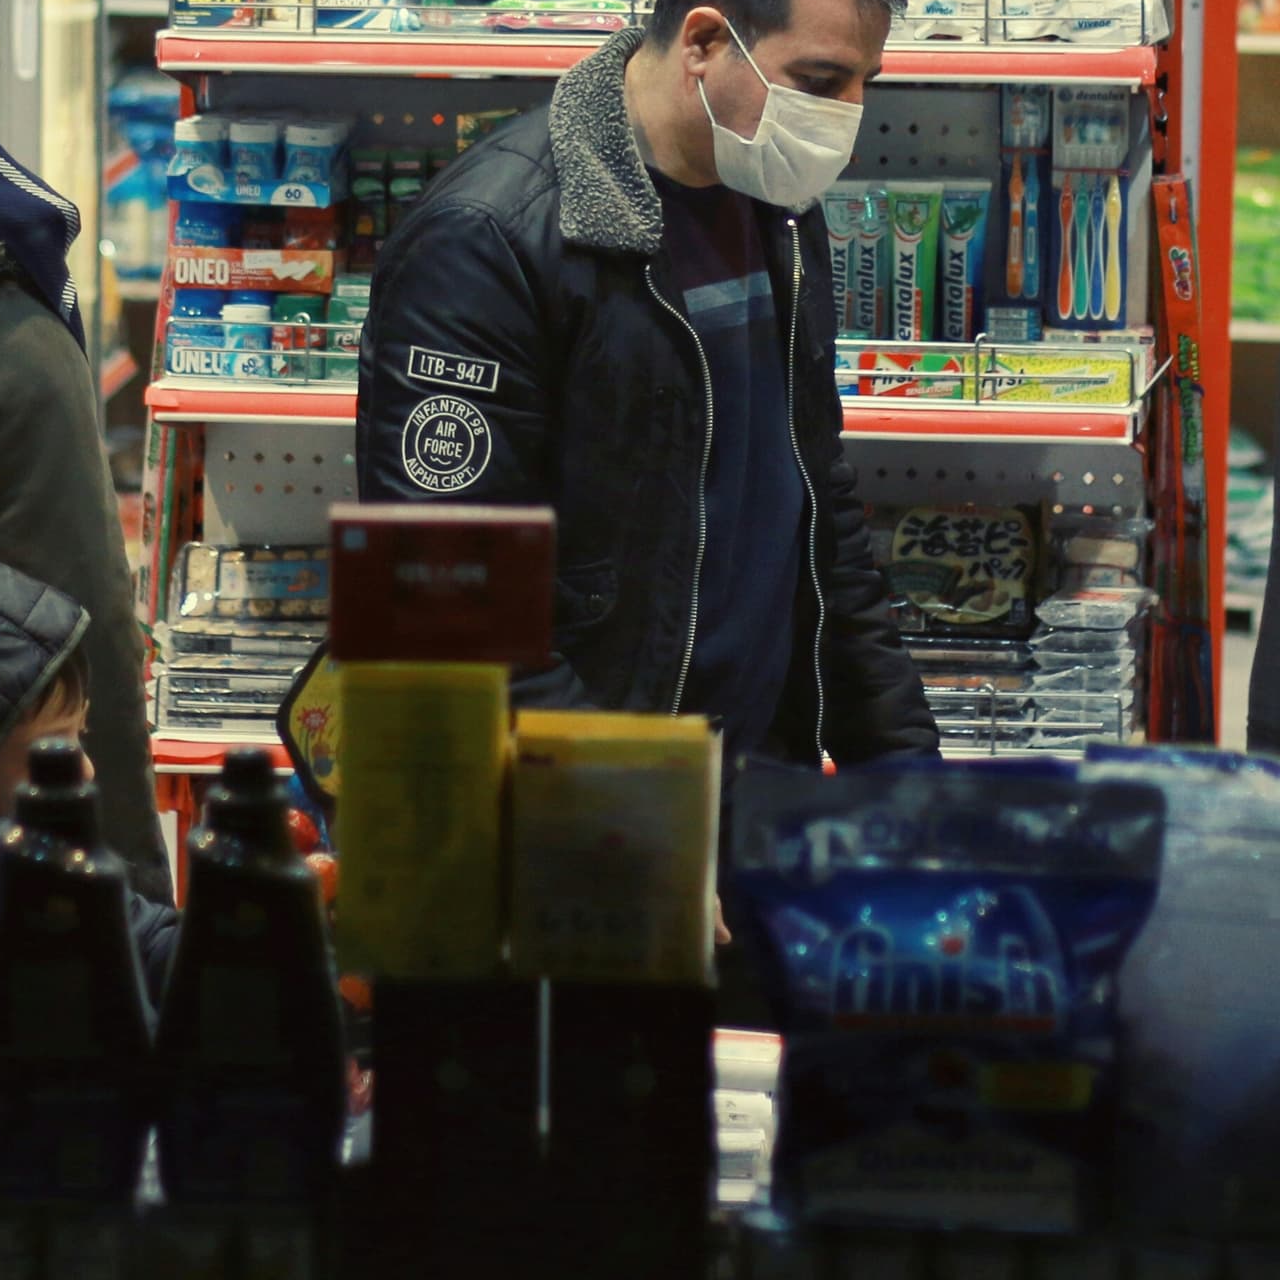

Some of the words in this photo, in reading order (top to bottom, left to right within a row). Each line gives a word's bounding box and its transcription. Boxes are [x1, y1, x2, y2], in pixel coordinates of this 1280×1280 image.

[284, 189, 301, 200] 60
[175, 257, 230, 284] ONEO
[857, 245, 875, 330] entalux
[895, 252, 914, 341] entalux
[946, 249, 965, 339] entalux
[335, 331, 360, 346] rel
[420, 355, 485, 384] LTB-947
[412, 399, 475, 426] INFANTRY
[469, 418, 485, 436] 98
[435, 420, 457, 438] AIR
[423, 437, 464, 458] FORCE
[406, 457, 440, 487] ALPHA
